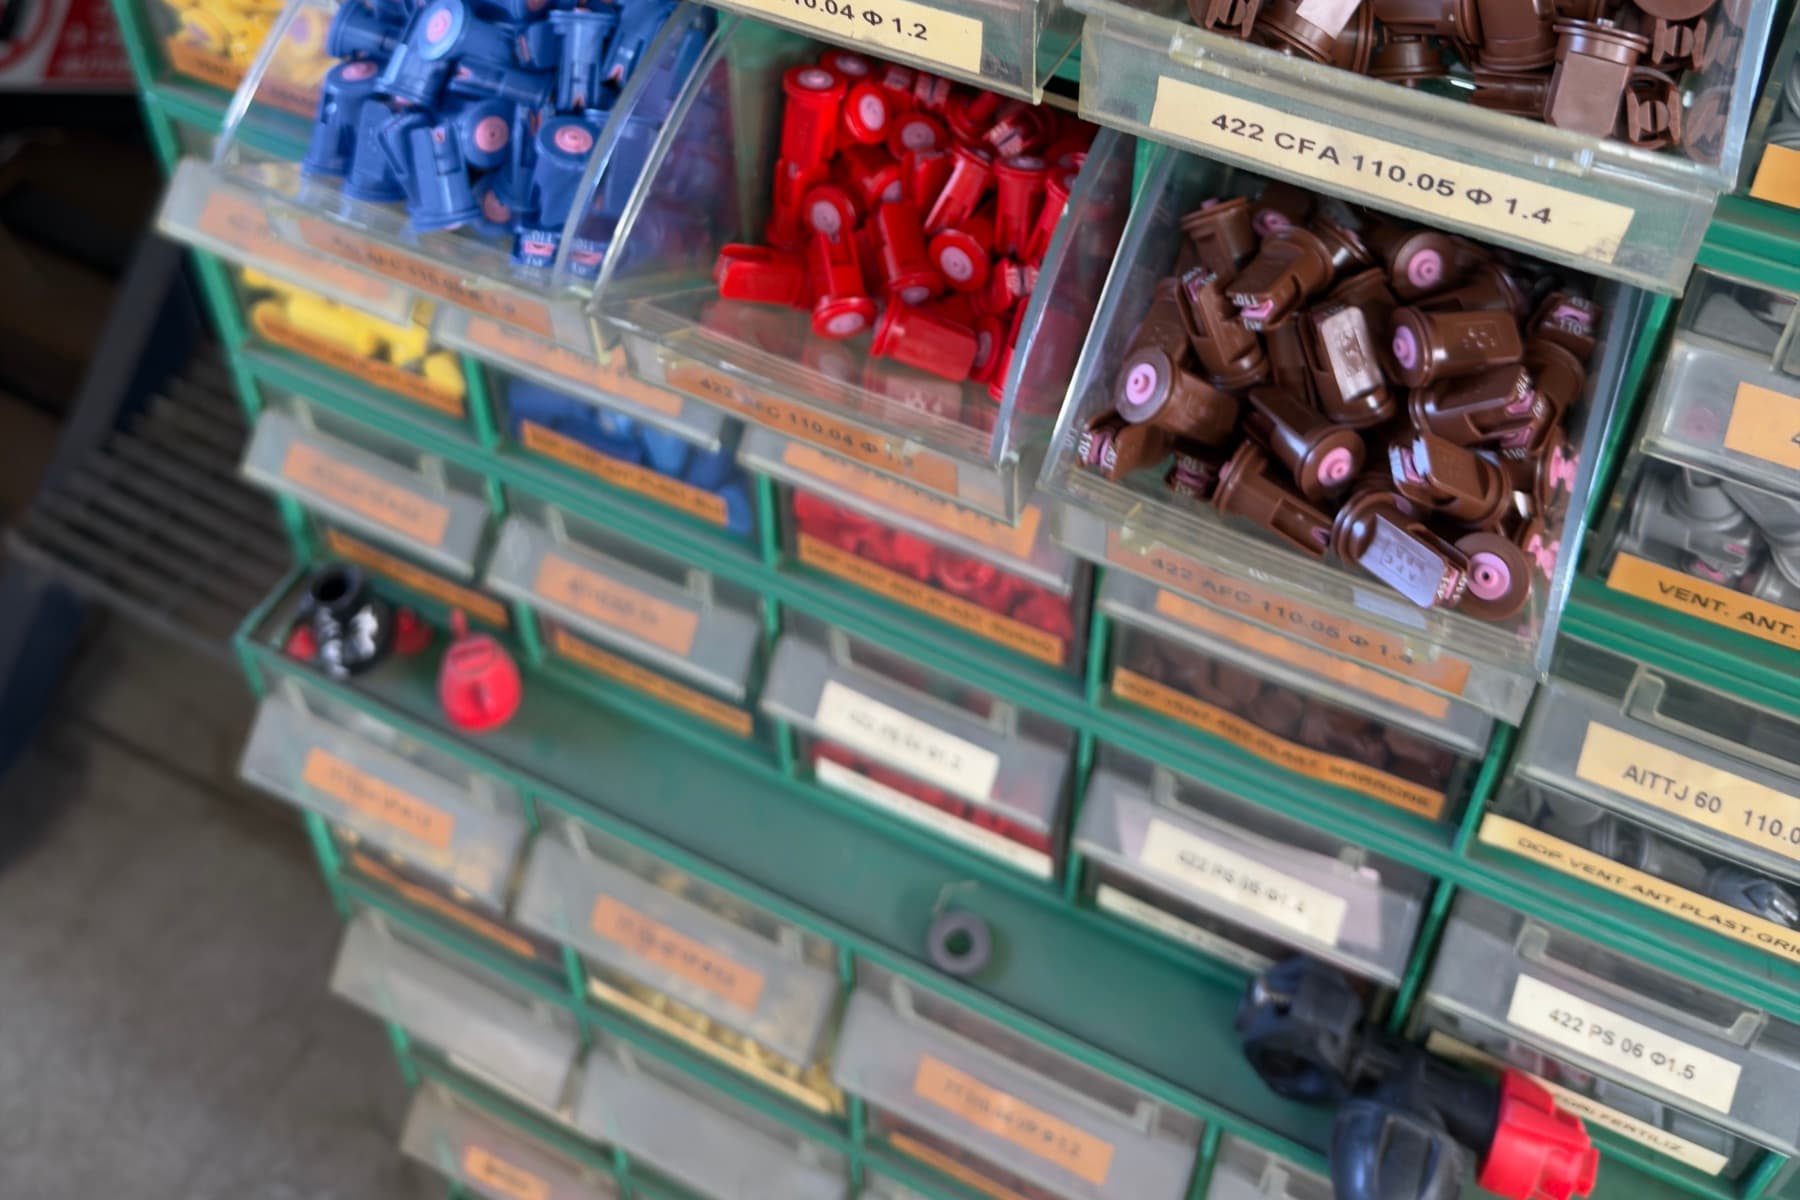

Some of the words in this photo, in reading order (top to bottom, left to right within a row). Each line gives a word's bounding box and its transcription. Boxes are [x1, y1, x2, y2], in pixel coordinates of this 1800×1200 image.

[891, 16, 929, 41] 1.2
[1211, 113, 1266, 143] 422
[1273, 131, 1342, 166] CFA
[1351, 153, 1456, 198] 110.05
[1504, 196, 1553, 225] 1.4
[1150, 557, 1194, 582] 422
[1201, 578, 1250, 602] AFC
[1658, 579, 1730, 618] VENT.
[1736, 610, 1797, 640] ANT.
[1622, 762, 1690, 802] AITTJ
[1694, 790, 1723, 815] 60
[1743, 808, 1800, 845] 110.0
[1548, 1007, 1584, 1033] 422
[1588, 1022, 1617, 1047] PS
[1620, 1037, 1645, 1060] 06
